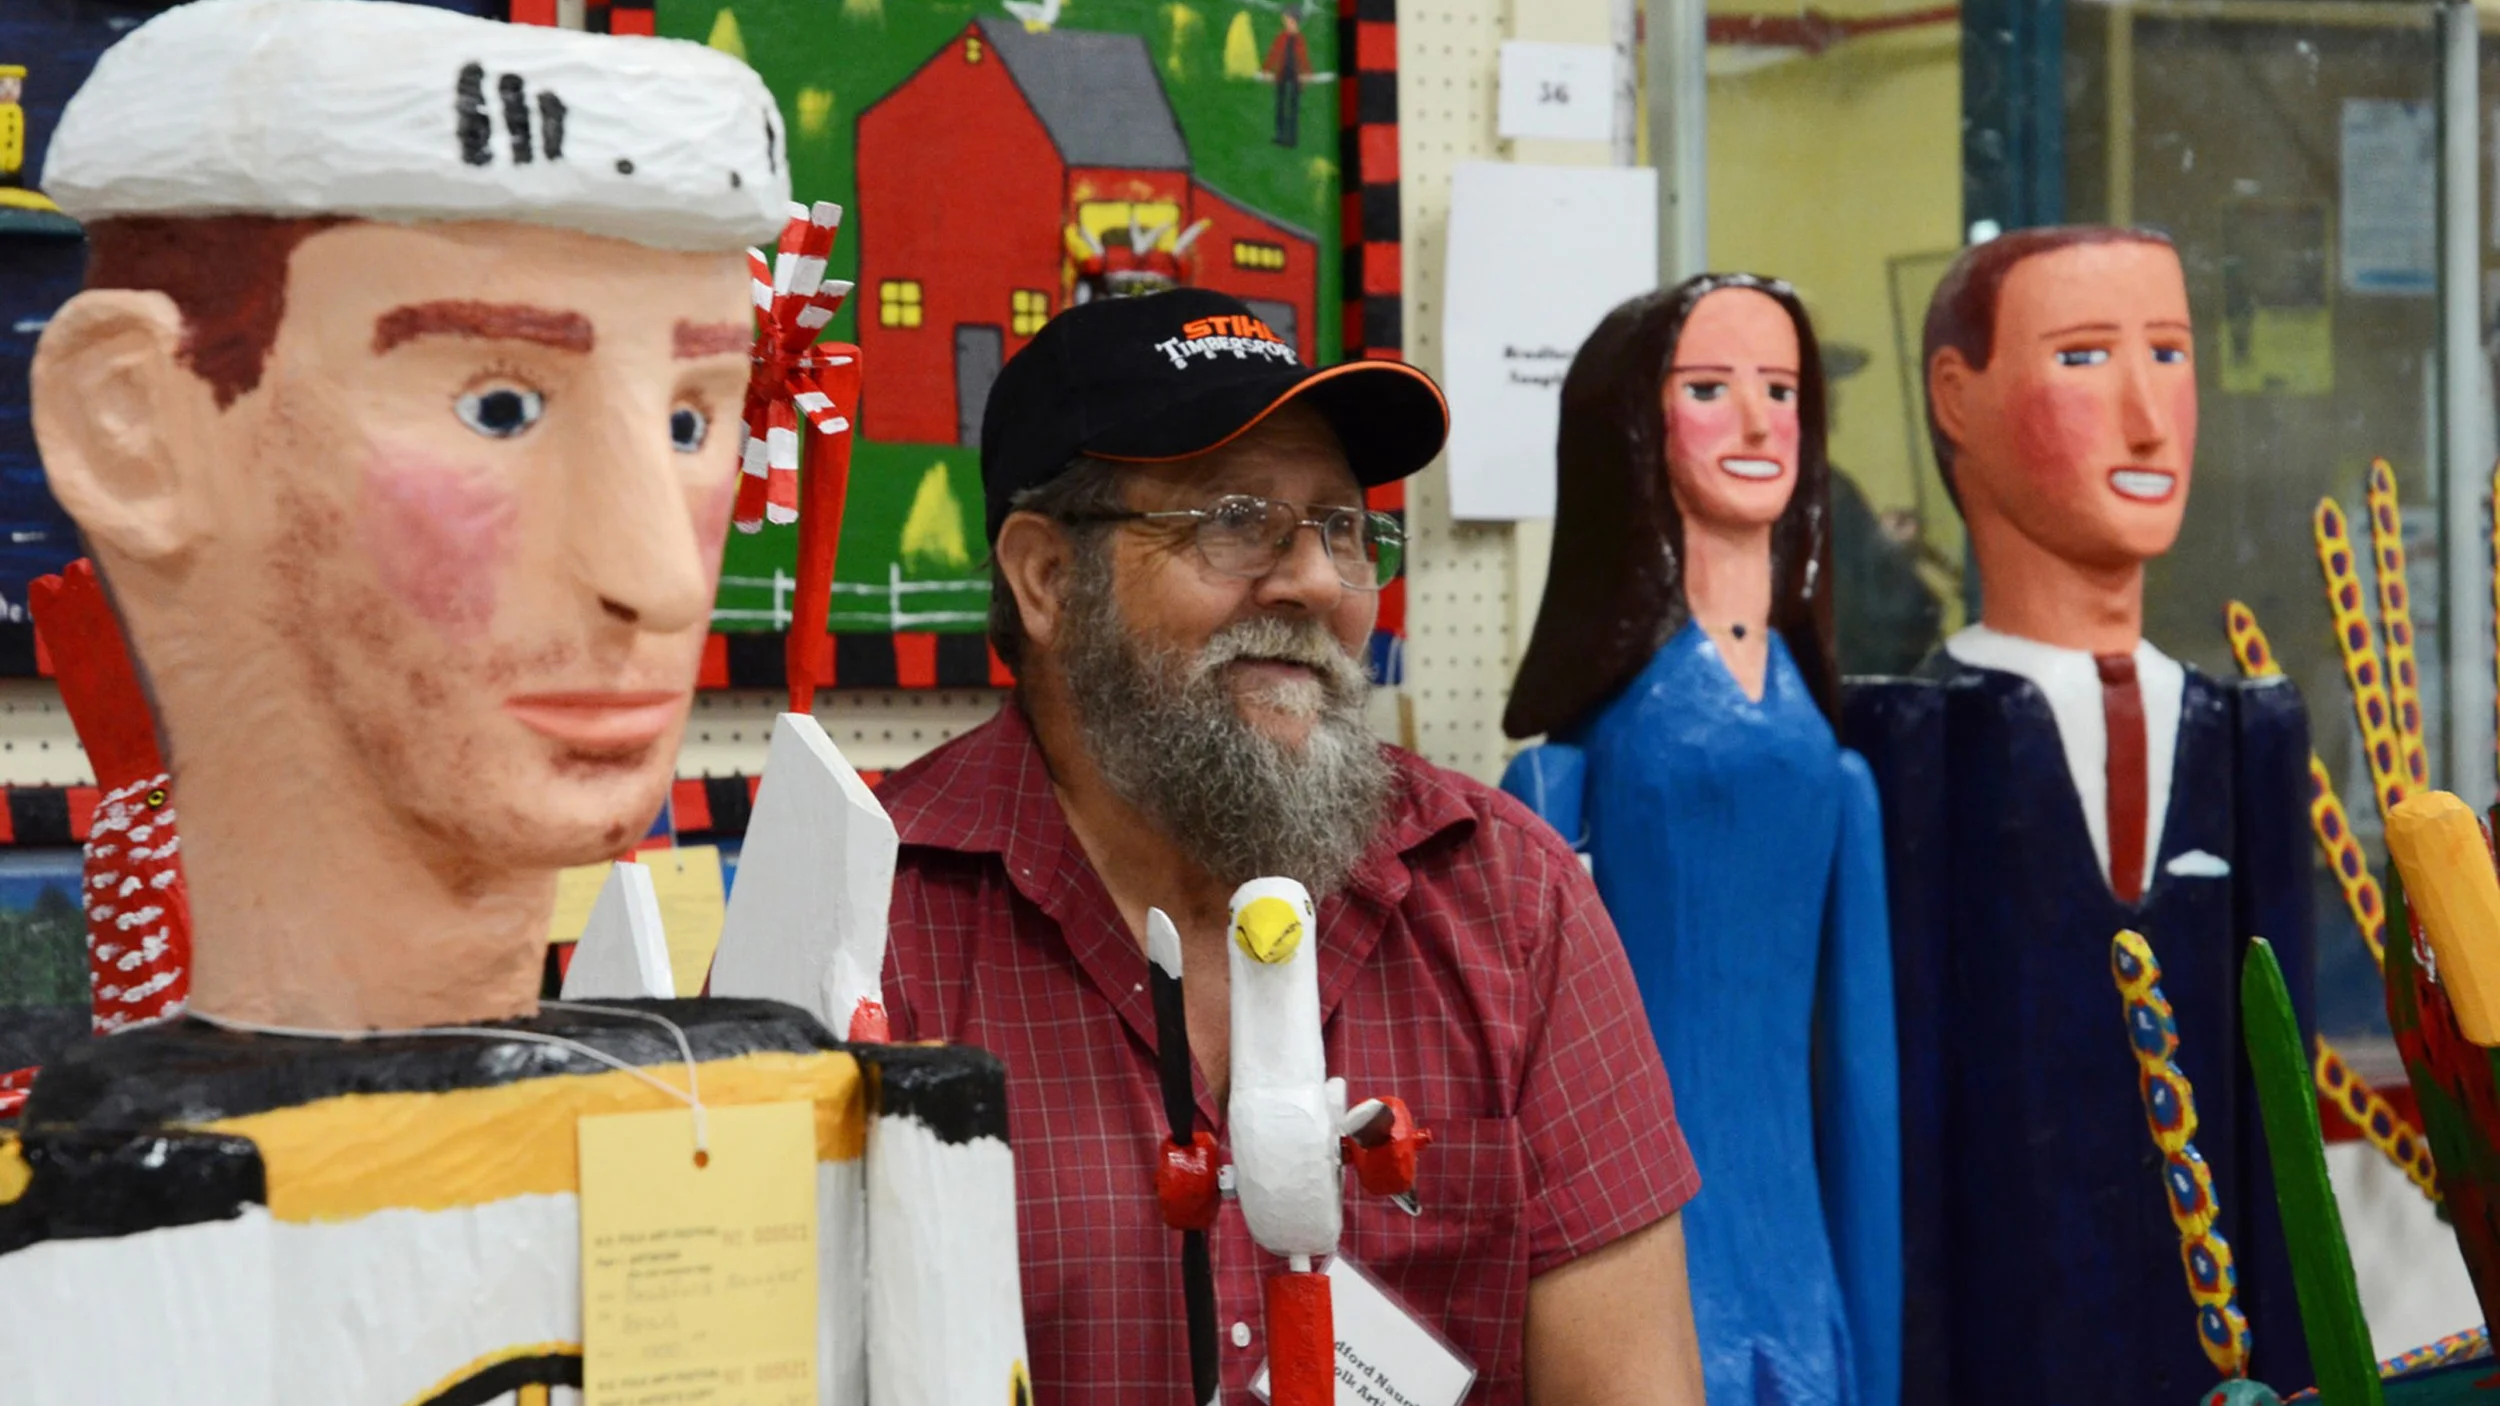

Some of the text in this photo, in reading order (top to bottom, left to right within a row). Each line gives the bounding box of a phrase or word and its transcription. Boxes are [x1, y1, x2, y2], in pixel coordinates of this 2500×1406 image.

[1182, 315, 1286, 343] STIHL
[1335, 1340, 1376, 1379] dford
[1334, 1365, 1357, 1389] olk
